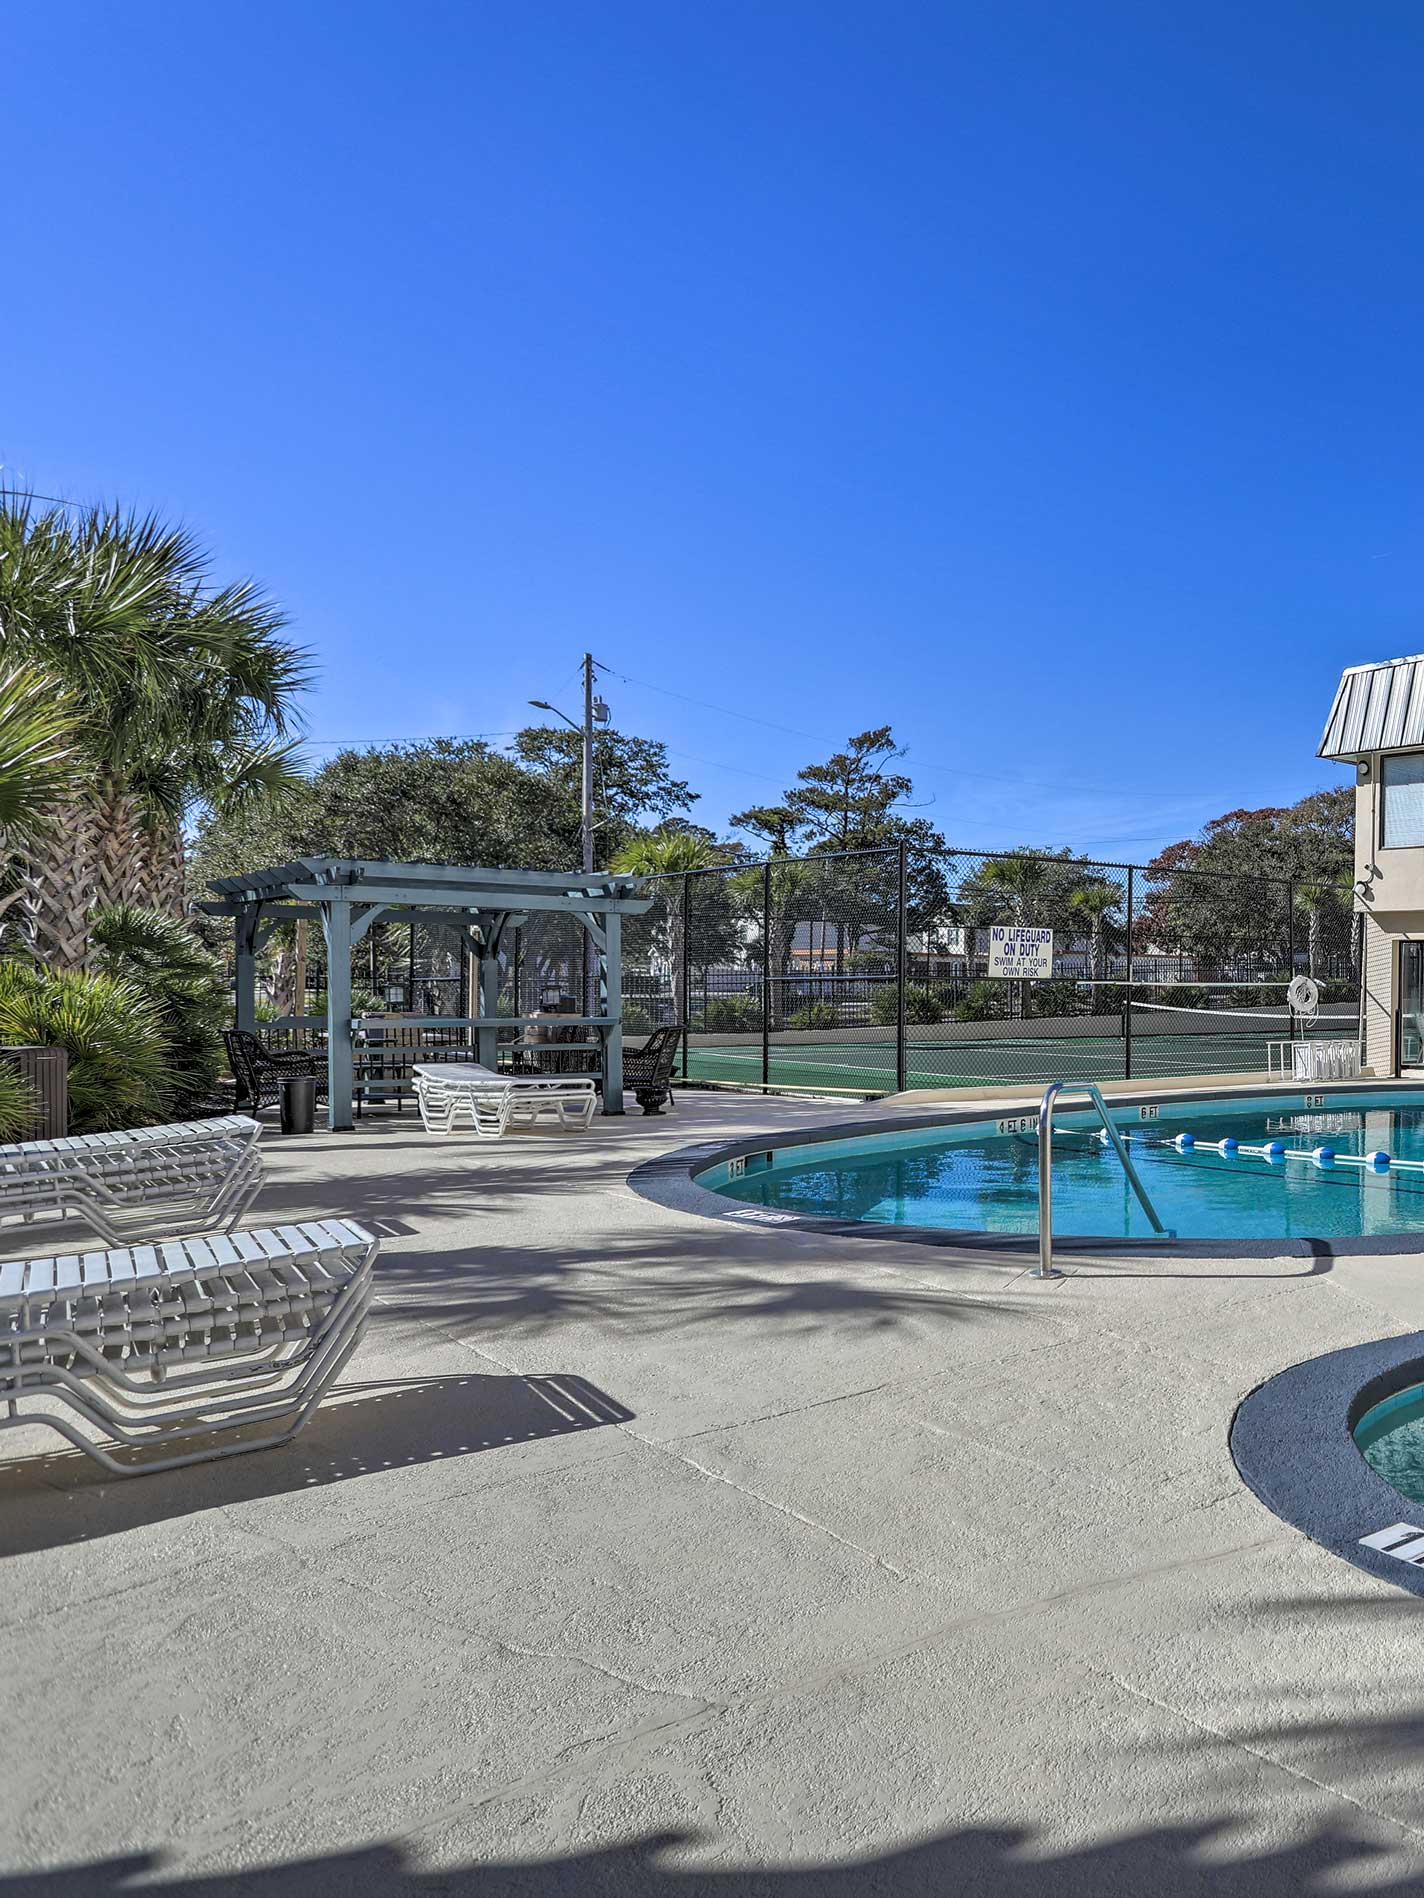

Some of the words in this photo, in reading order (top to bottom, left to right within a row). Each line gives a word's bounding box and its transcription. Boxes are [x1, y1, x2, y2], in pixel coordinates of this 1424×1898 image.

[992, 928, 1004, 941] NO
[1008, 929, 1051, 943] LIFEGUARD
[1004, 943, 1015, 956] ON
[1020, 944, 1040, 957] DUTY
[994, 957, 1013, 966] SWIM
[1016, 958, 1025, 967] AT
[1029, 958, 1048, 968] YOUR
[1003, 967, 1019, 976] OWN
[1023, 968, 1039, 977] RISK
